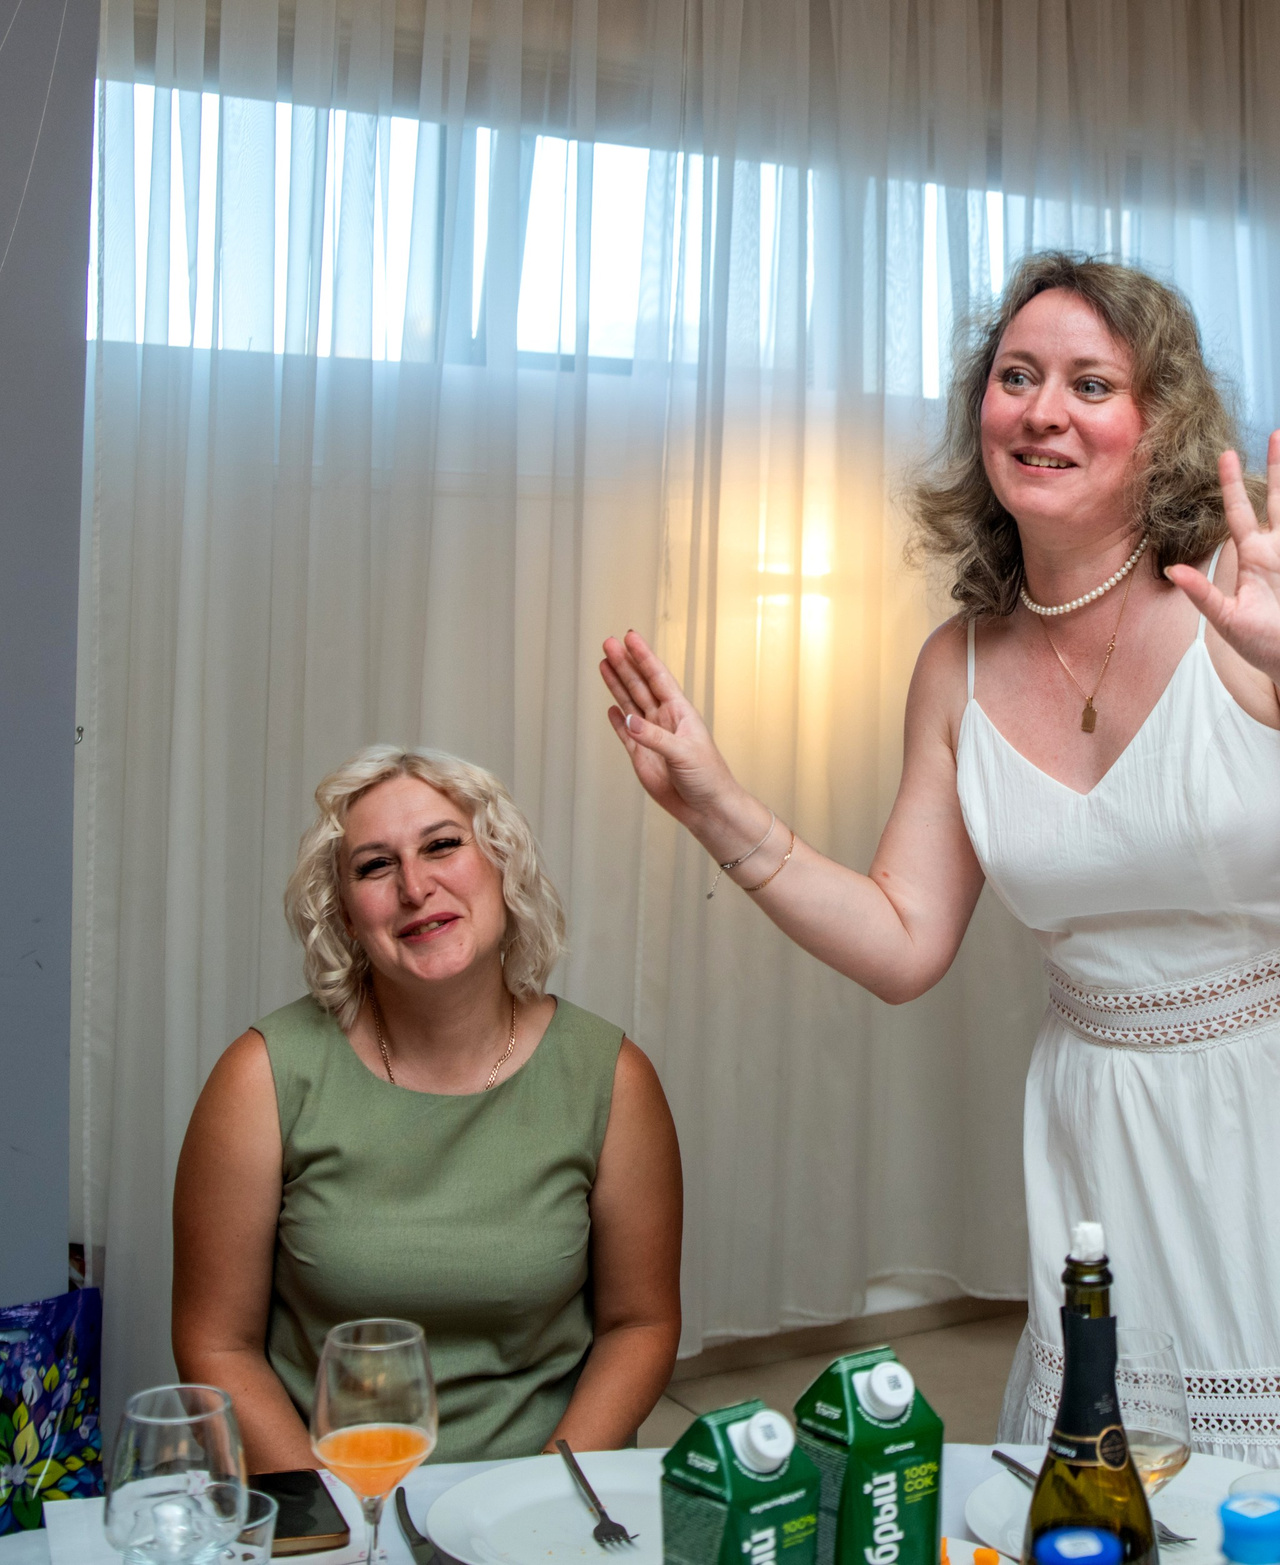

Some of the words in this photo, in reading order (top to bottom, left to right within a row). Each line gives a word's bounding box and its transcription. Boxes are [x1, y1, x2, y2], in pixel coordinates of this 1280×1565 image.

[904, 1462, 938, 1479] 100%
[904, 1475, 934, 1492] СОК
[782, 1514, 817, 1534] 100%
[863, 1471, 904, 1565] брый
